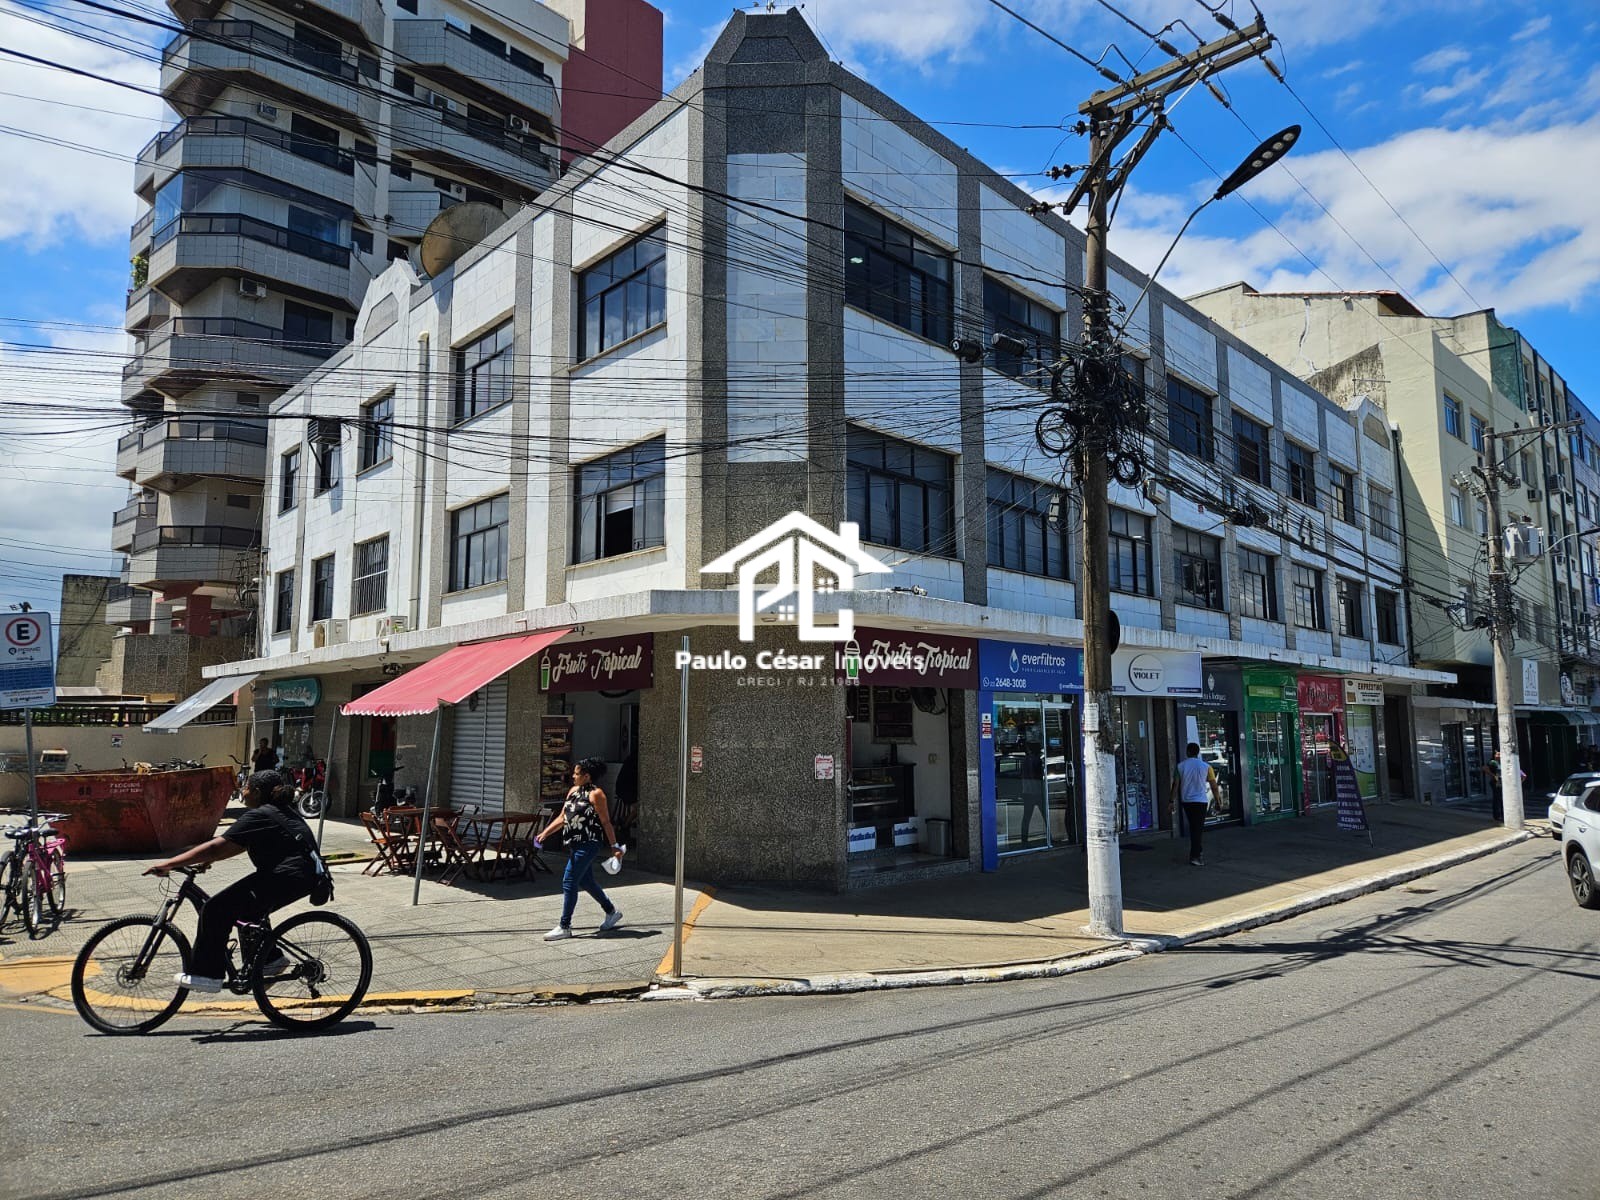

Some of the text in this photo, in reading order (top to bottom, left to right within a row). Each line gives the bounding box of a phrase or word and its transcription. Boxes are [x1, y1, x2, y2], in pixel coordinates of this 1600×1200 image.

[16, 623, 30, 641] E
[552, 645, 643, 683] Fruto Topical
[917, 642, 972, 676] Tropical
[1022, 653, 1066, 667] everfiltros
[996, 677, 1027, 689] 2648-3008
[1133, 671, 1160, 681] VIOLET
